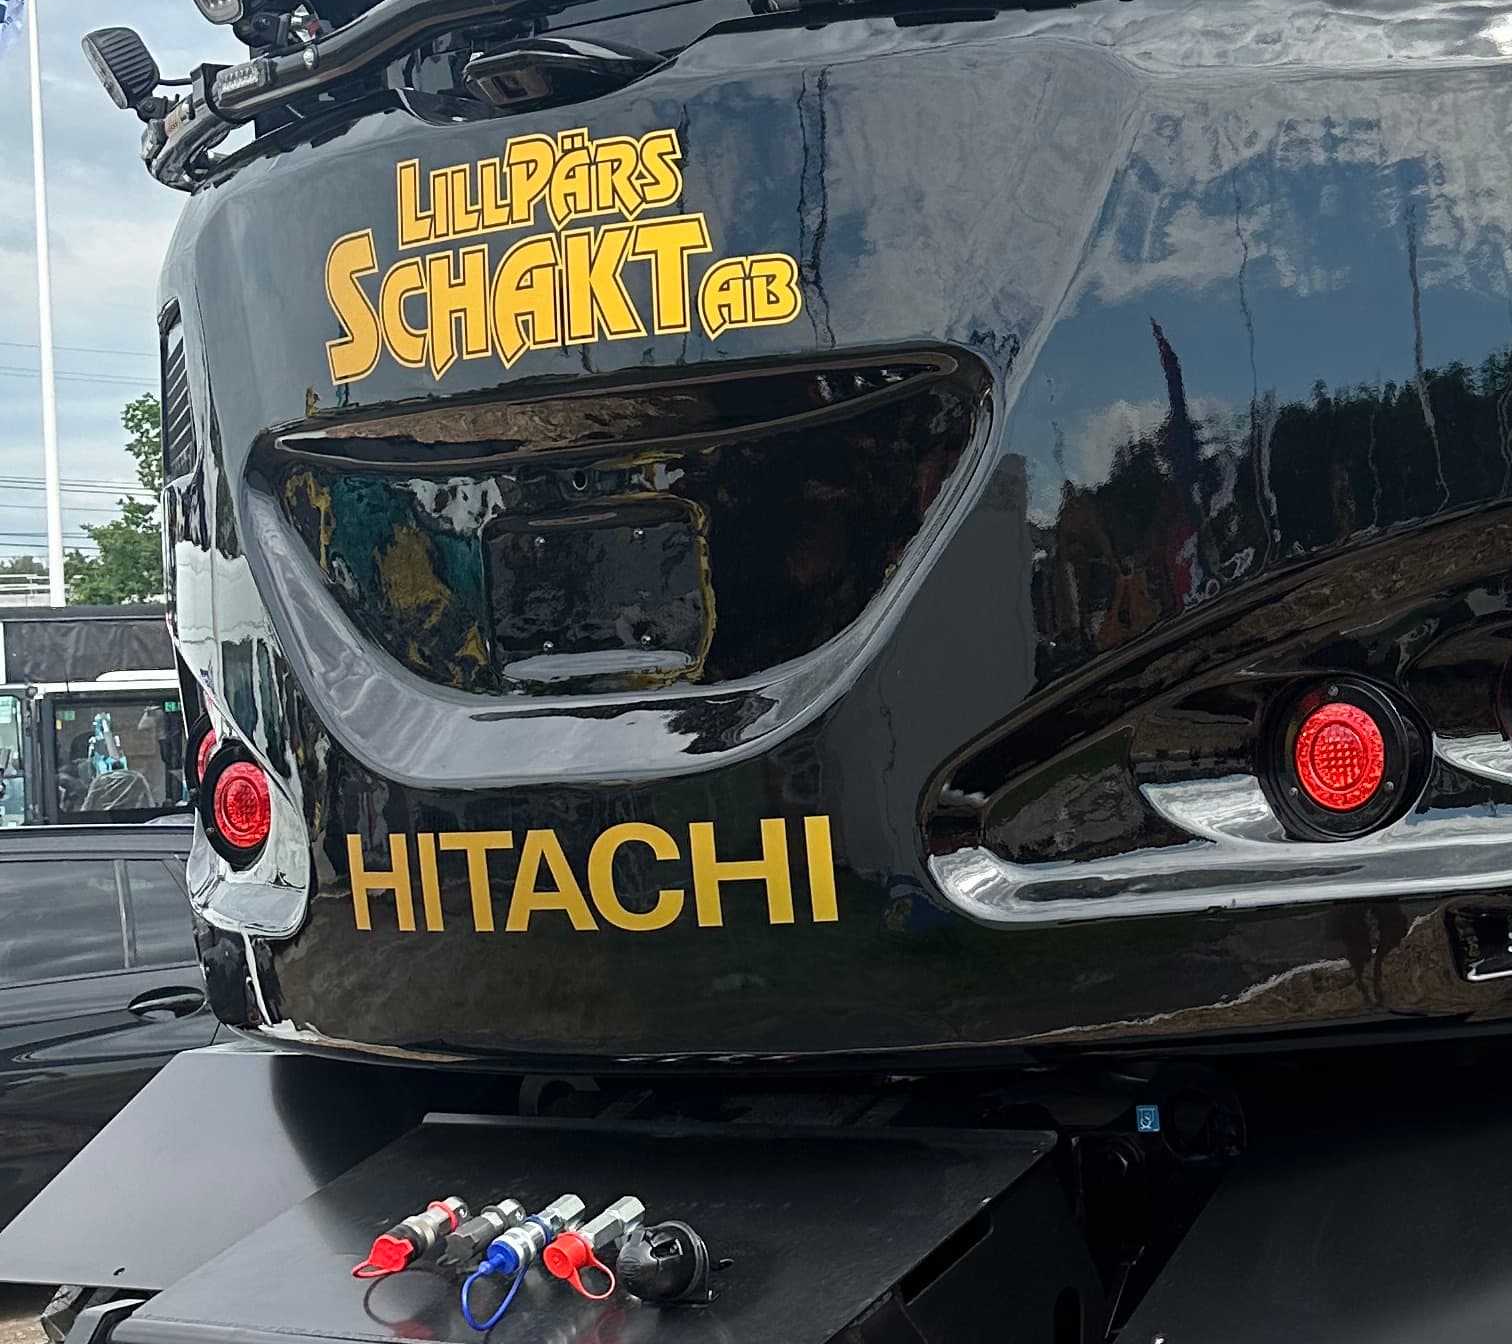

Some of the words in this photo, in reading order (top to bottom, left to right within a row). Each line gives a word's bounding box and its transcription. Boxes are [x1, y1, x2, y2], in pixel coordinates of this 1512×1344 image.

[395, 127, 684, 250] LILLPÄRS
[325, 213, 711, 384] SCHAKT
[697, 252, 803, 339] AB
[347, 814, 839, 932] HITACHI
